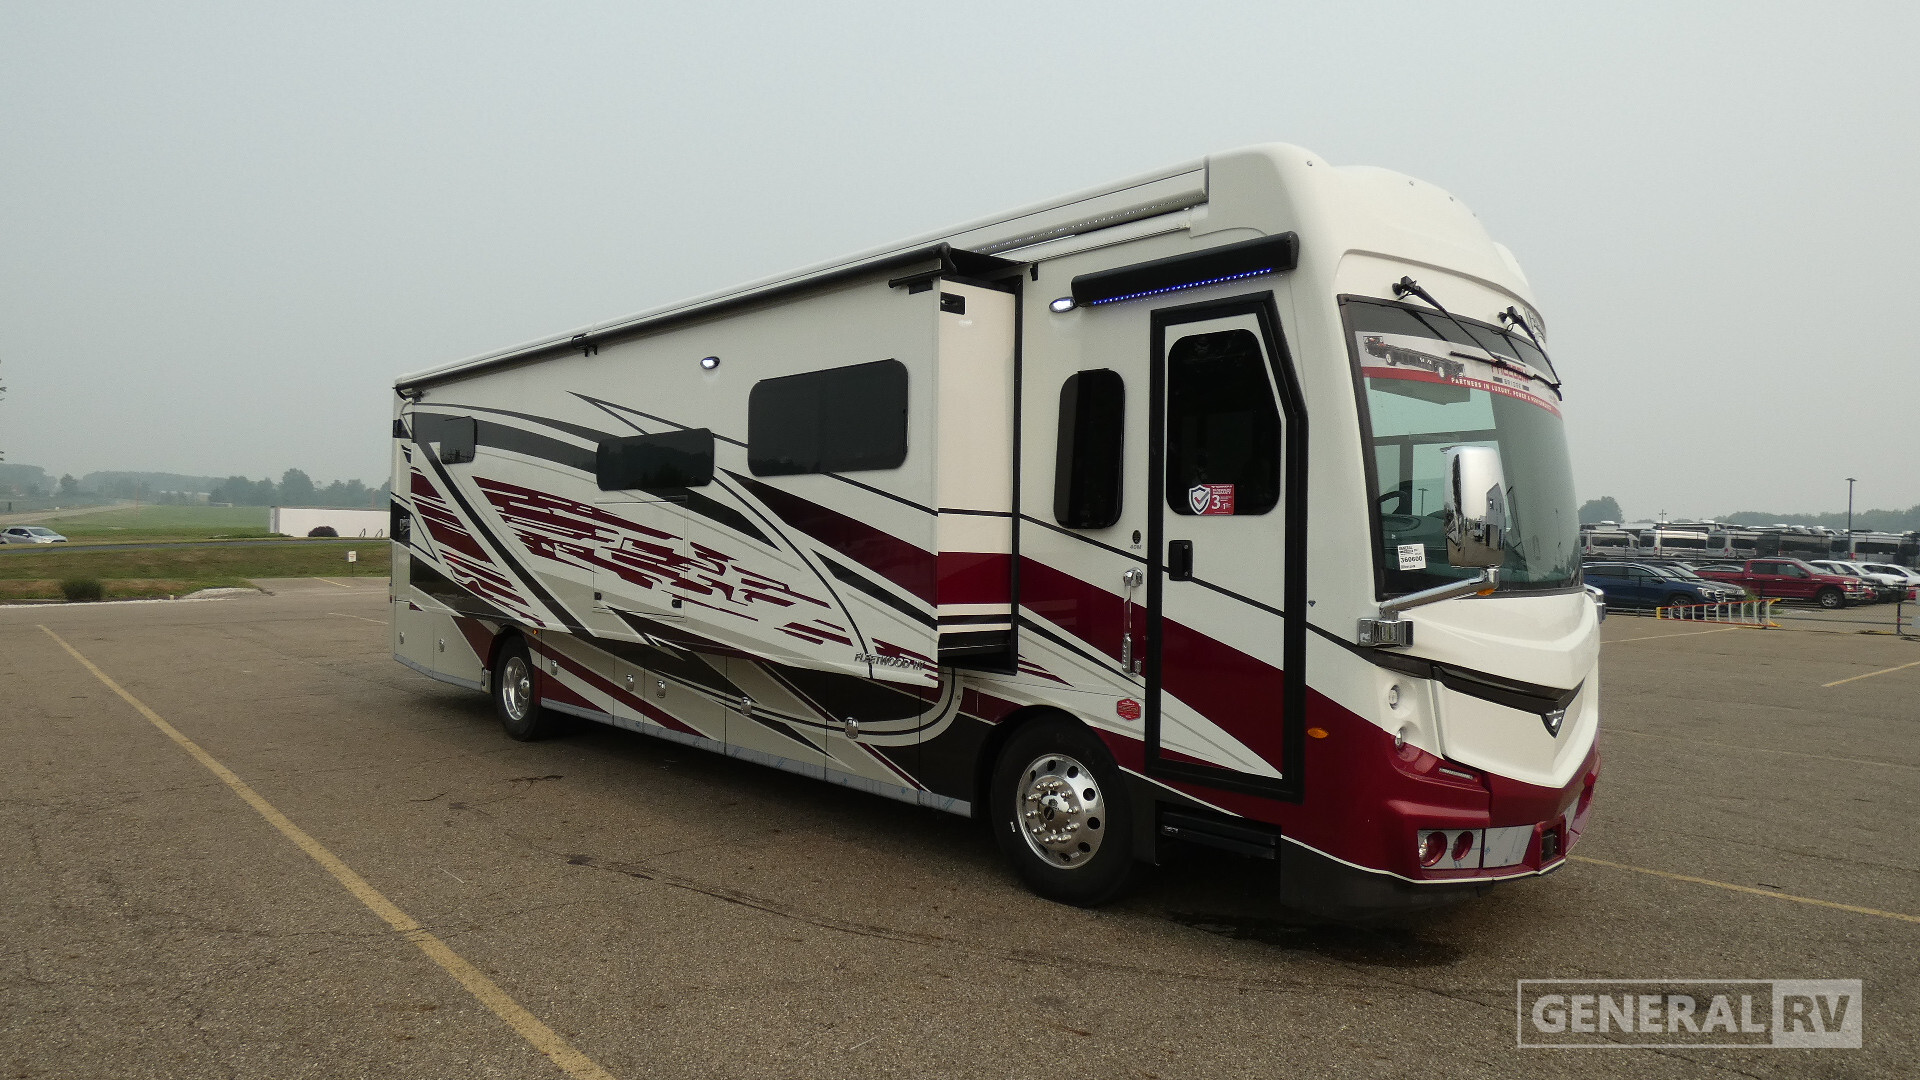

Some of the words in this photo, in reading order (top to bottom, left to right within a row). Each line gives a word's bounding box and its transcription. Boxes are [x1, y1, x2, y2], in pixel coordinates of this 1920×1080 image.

[1451, 377, 1482, 388] PARTNERS
[1211, 494, 1221, 509] 3
[855, 652, 911, 669] FLEETWOOD
